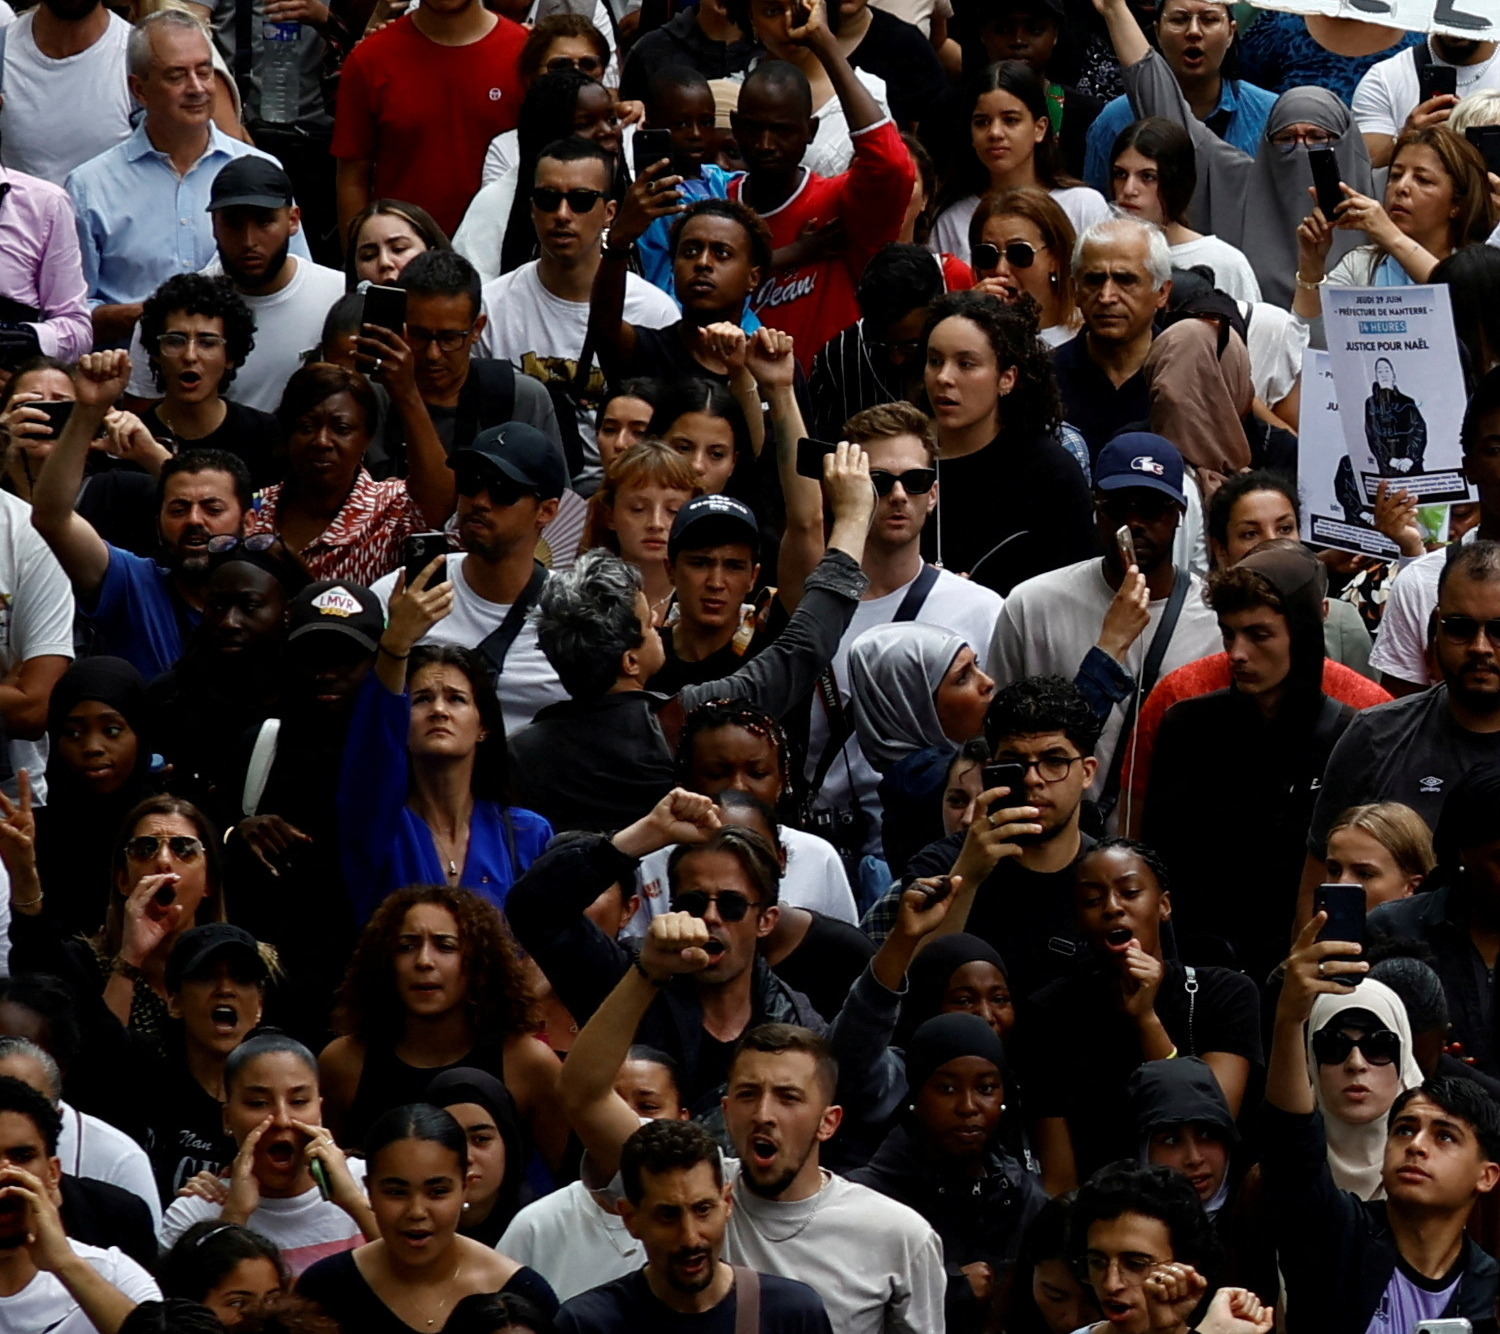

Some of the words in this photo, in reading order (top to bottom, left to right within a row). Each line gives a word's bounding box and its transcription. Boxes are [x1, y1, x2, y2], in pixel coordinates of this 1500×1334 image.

[1355, 295, 1375, 305] JEUDI
[1386, 295, 1403, 304] JUIN
[1378, 307, 1388, 316] DE
[1389, 306, 1428, 316] NANTERRE
[1370, 320, 1407, 333] HEURES
[1345, 341, 1376, 352] JUSTICE
[1377, 341, 1403, 352] POUR
[1404, 338, 1430, 351] NAËL
[319, 596, 355, 612] LMVR
